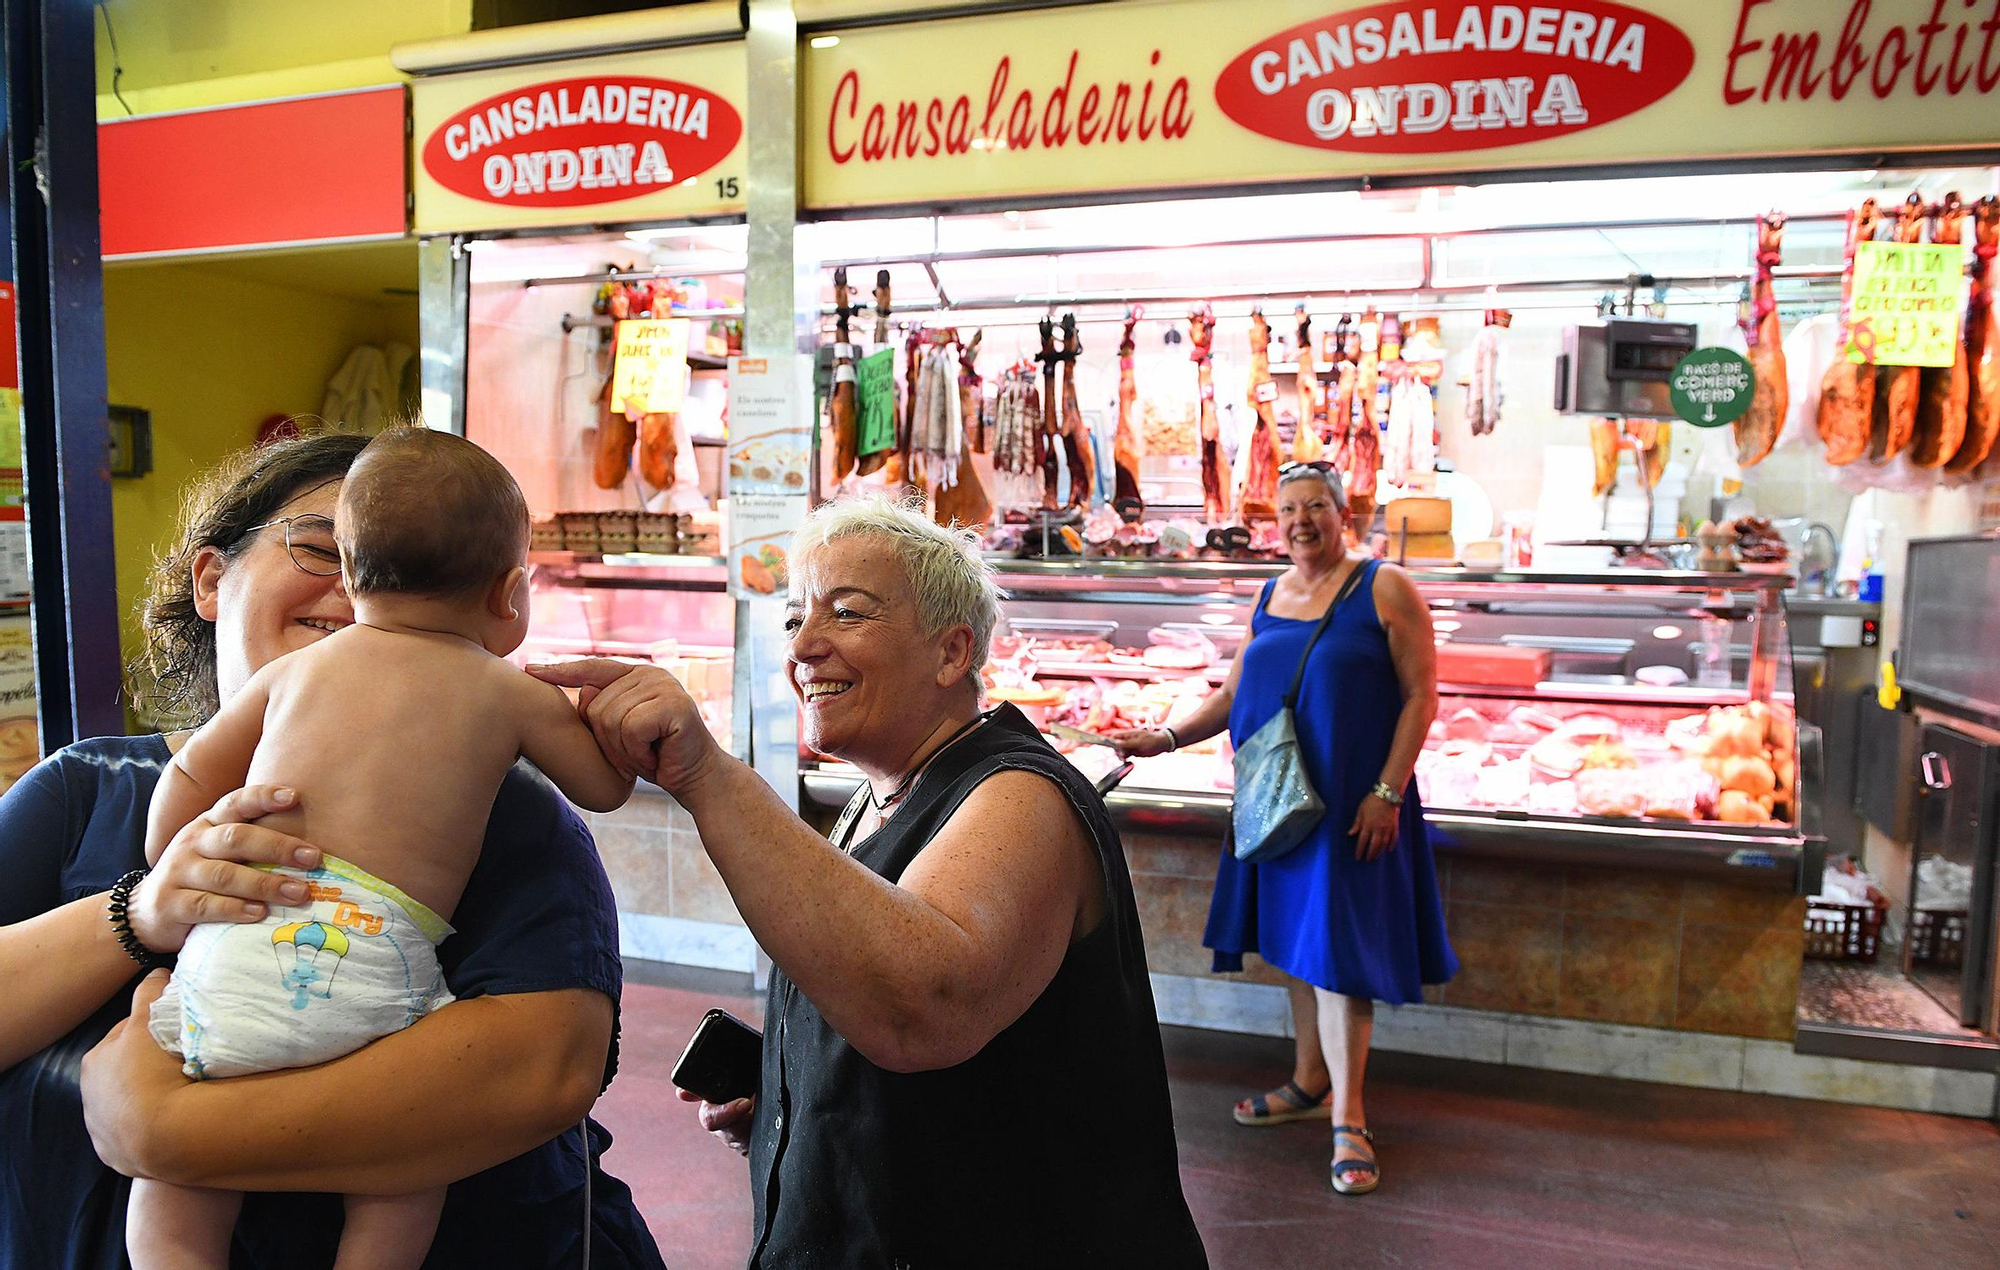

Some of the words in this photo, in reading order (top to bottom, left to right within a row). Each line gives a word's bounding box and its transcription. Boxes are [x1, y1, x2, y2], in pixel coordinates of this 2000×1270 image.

[1250, 4, 1647, 95] CANSALADERIA
[444, 85, 710, 161] CANSALADERIA
[828, 48, 1194, 165] Cansaladeria
[1306, 73, 1589, 140] ONDINA
[482, 140, 674, 198] ONDINA
[715, 177, 739, 199] 15
[1686, 387, 1736, 403] VERD
[1722, 361, 1742, 374] DE
[332, 901, 384, 935] Dry
